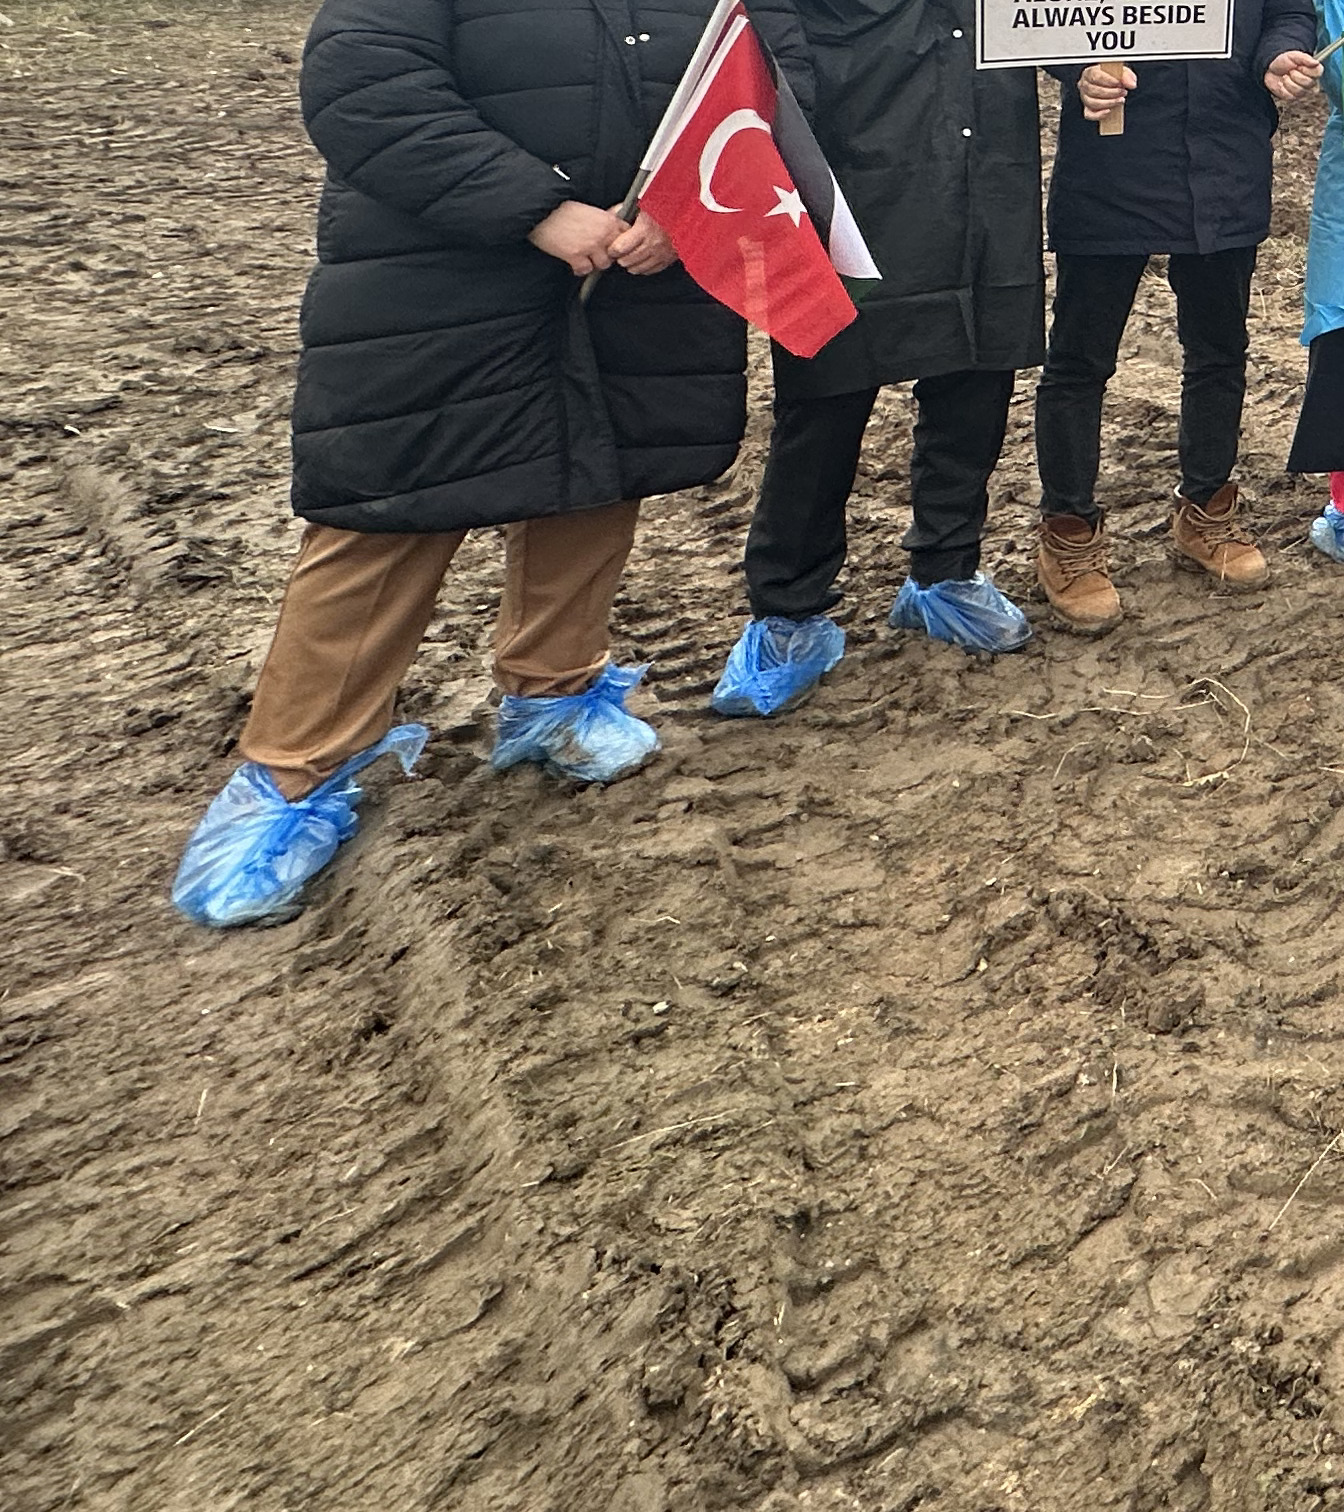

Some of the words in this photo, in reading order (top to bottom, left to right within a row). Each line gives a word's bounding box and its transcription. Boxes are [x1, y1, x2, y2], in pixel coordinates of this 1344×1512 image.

[1012, 6, 1114, 29] ALWAYS
[1122, 4, 1206, 25] BESIDE
[1086, 30, 1136, 51] YOU
